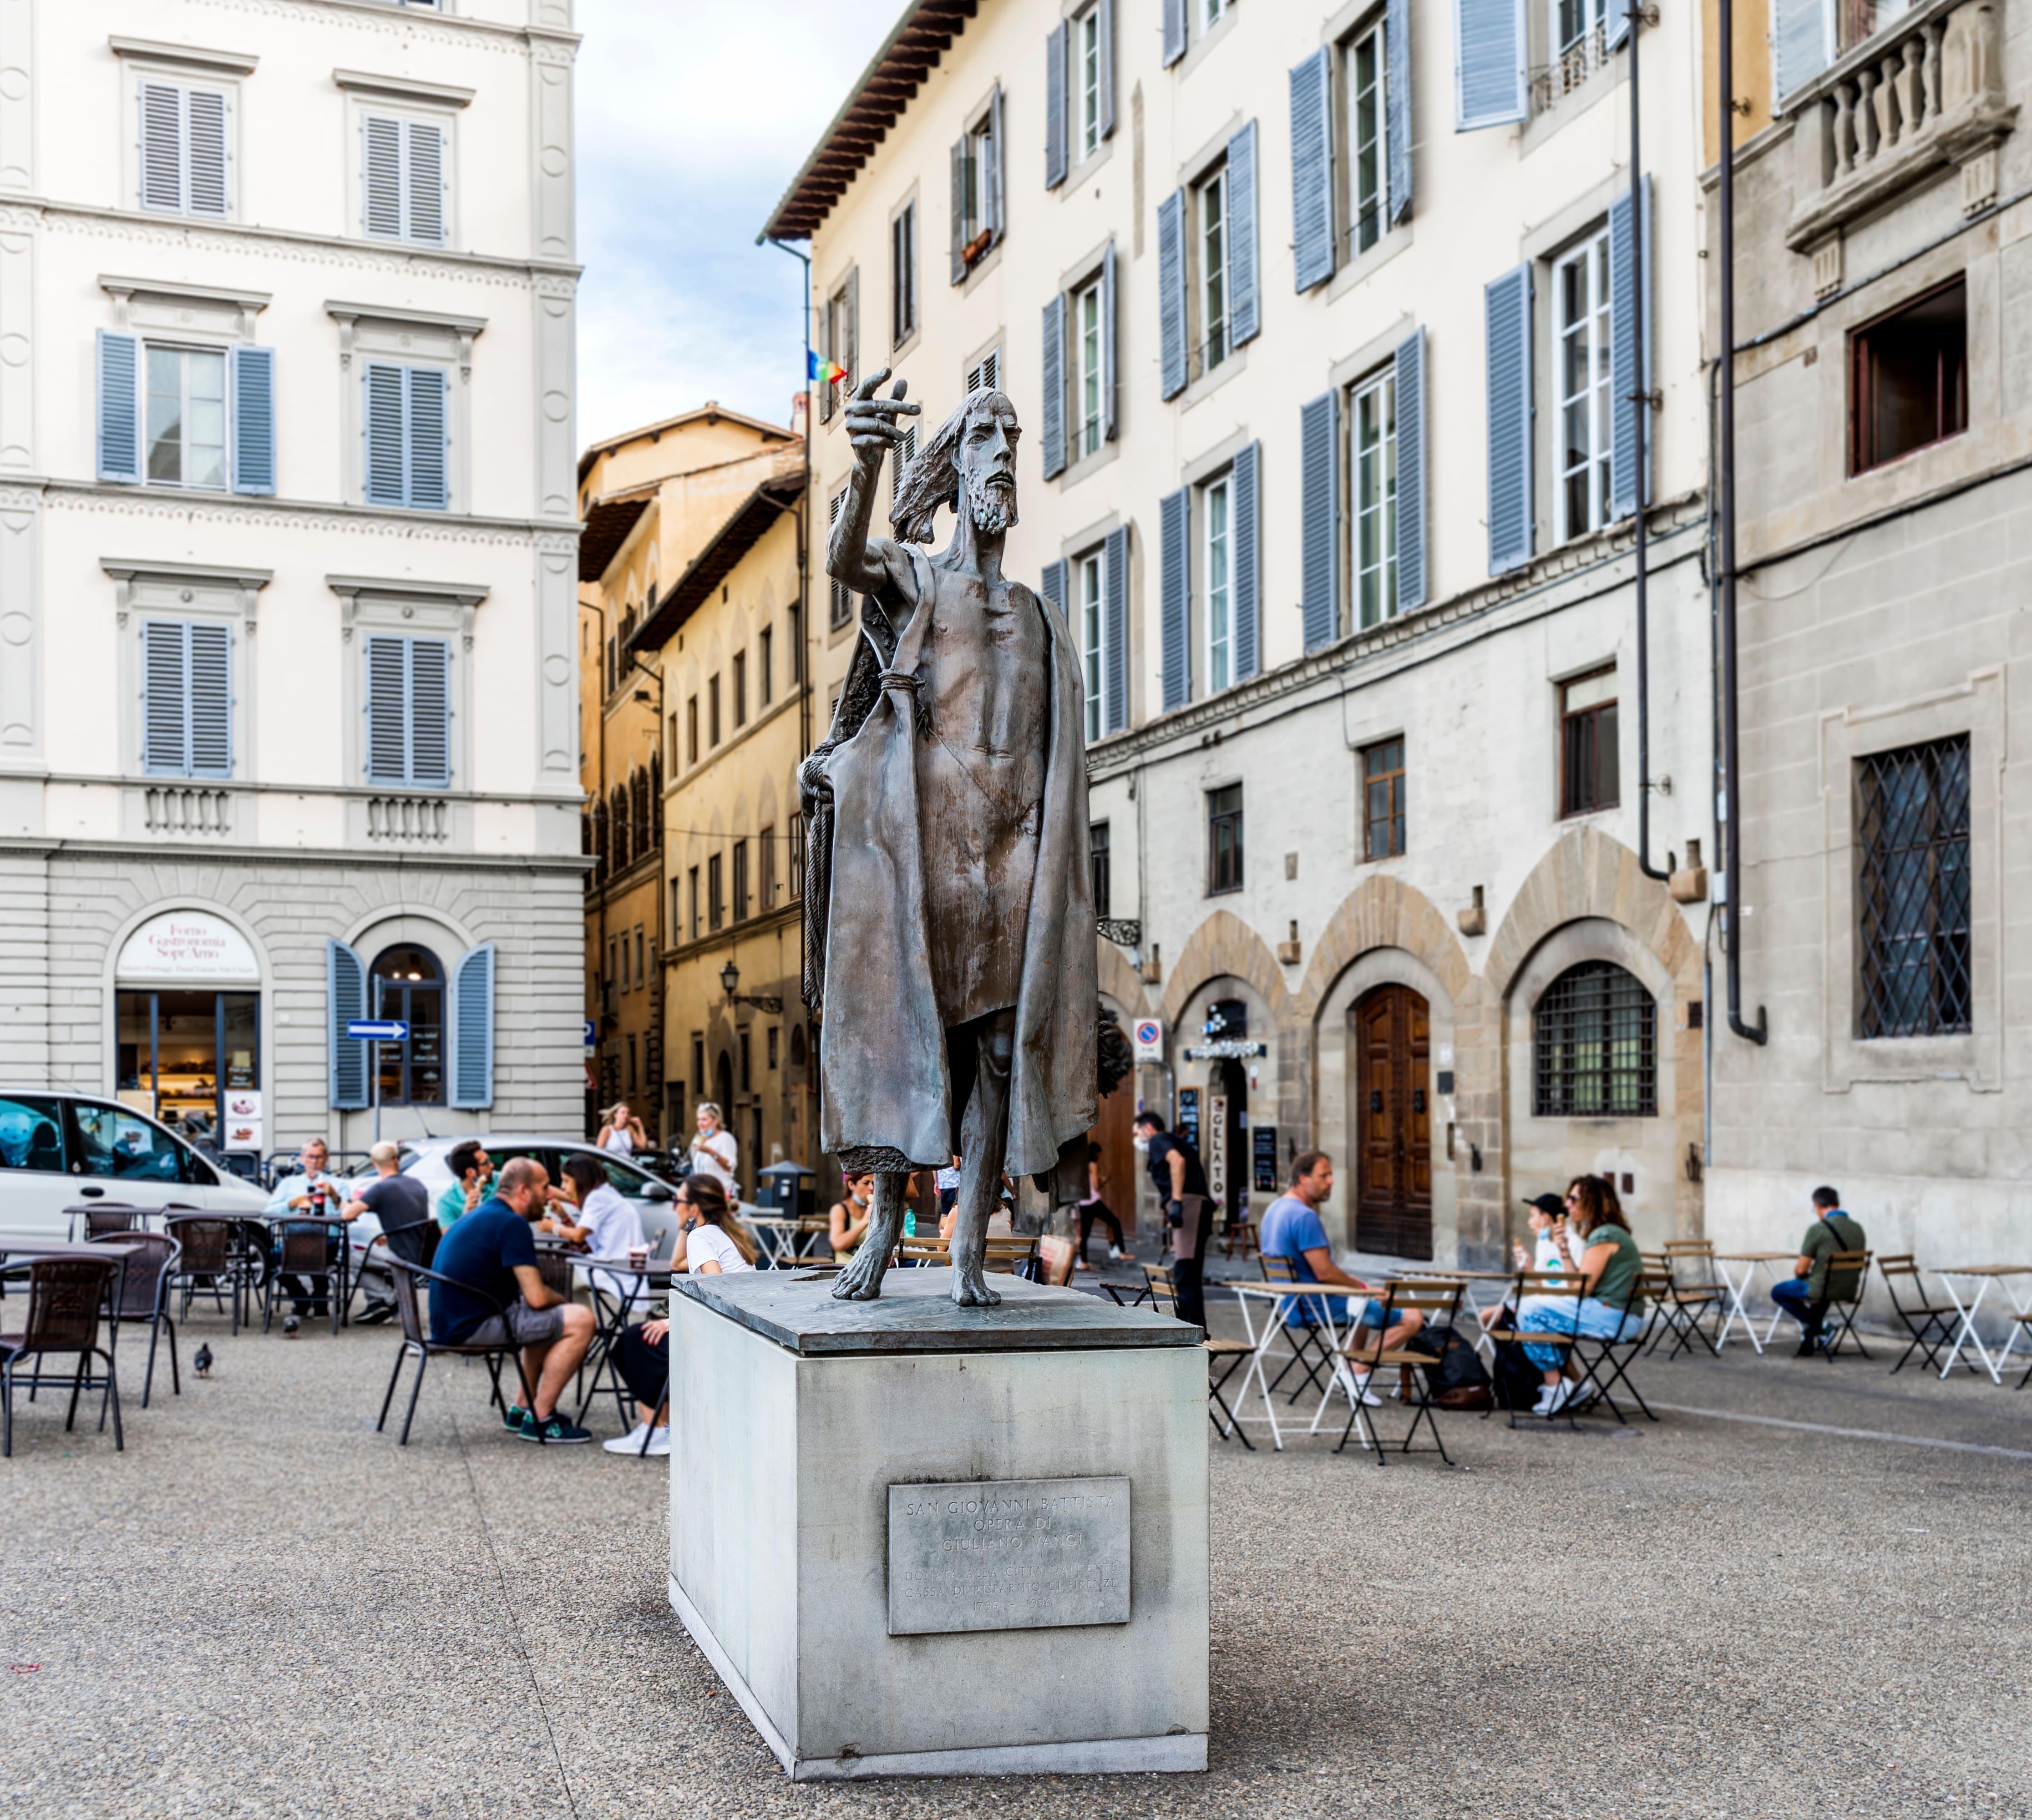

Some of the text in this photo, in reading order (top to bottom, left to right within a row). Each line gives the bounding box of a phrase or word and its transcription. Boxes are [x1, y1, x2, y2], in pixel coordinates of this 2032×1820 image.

[1213, 1115, 1223, 1193] GELATO
[907, 1496, 1115, 1516] SAN GIOVANNI BATTISTA
[974, 1517, 1051, 1531] OPERA DI
[942, 1534, 1082, 1551] GIULIANO VANGI
[905, 1570, 957, 1581] DONATA
[966, 1568, 997, 1578] ALLA
[905, 1578, 1117, 1598] CASSA DI RISPARMIO DI FIRENZE
[973, 1601, 998, 1611] 1796
